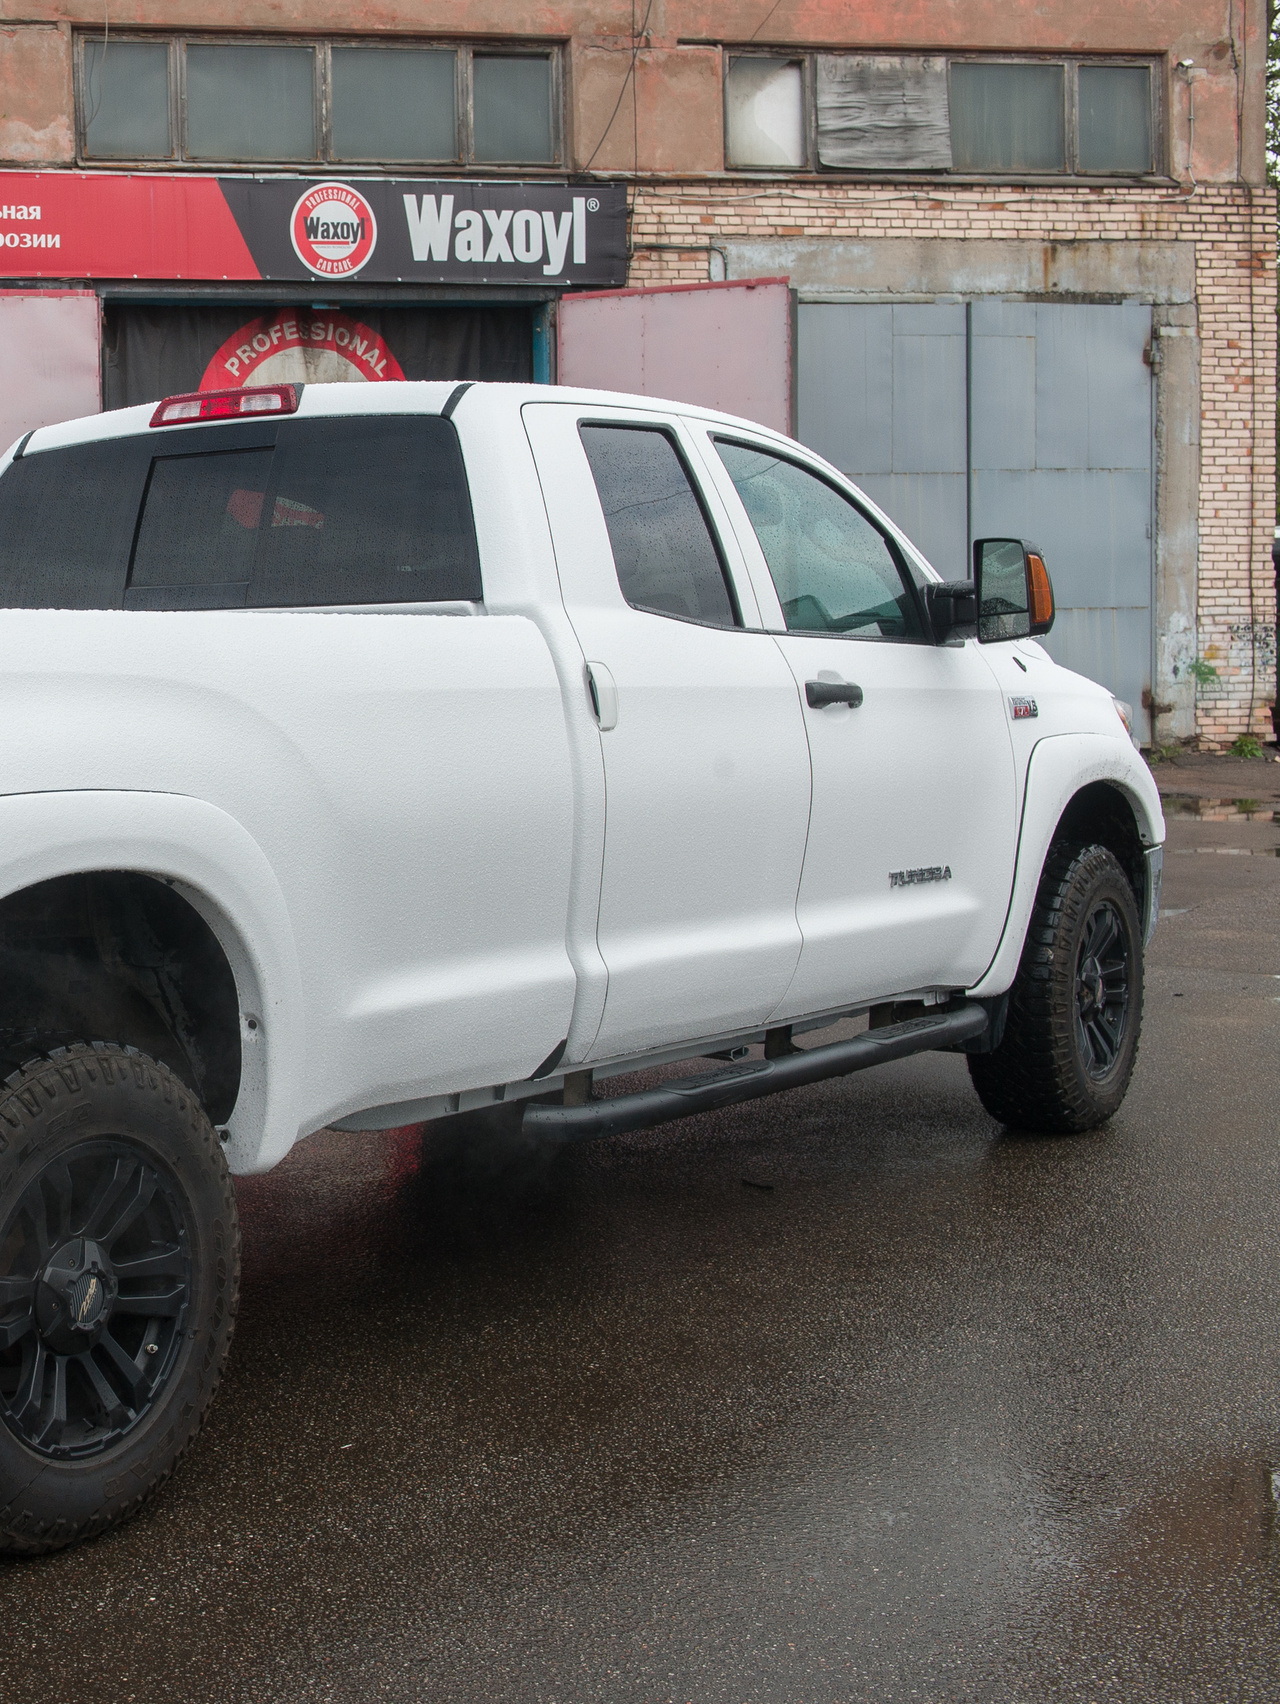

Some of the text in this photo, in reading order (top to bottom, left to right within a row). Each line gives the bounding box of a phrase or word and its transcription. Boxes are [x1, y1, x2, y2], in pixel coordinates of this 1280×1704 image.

[305, 188, 361, 210] PROFESSIONAL
[316, 258, 353, 273] CAR CARE
[224, 320, 390, 378] PROFESSIONAL
